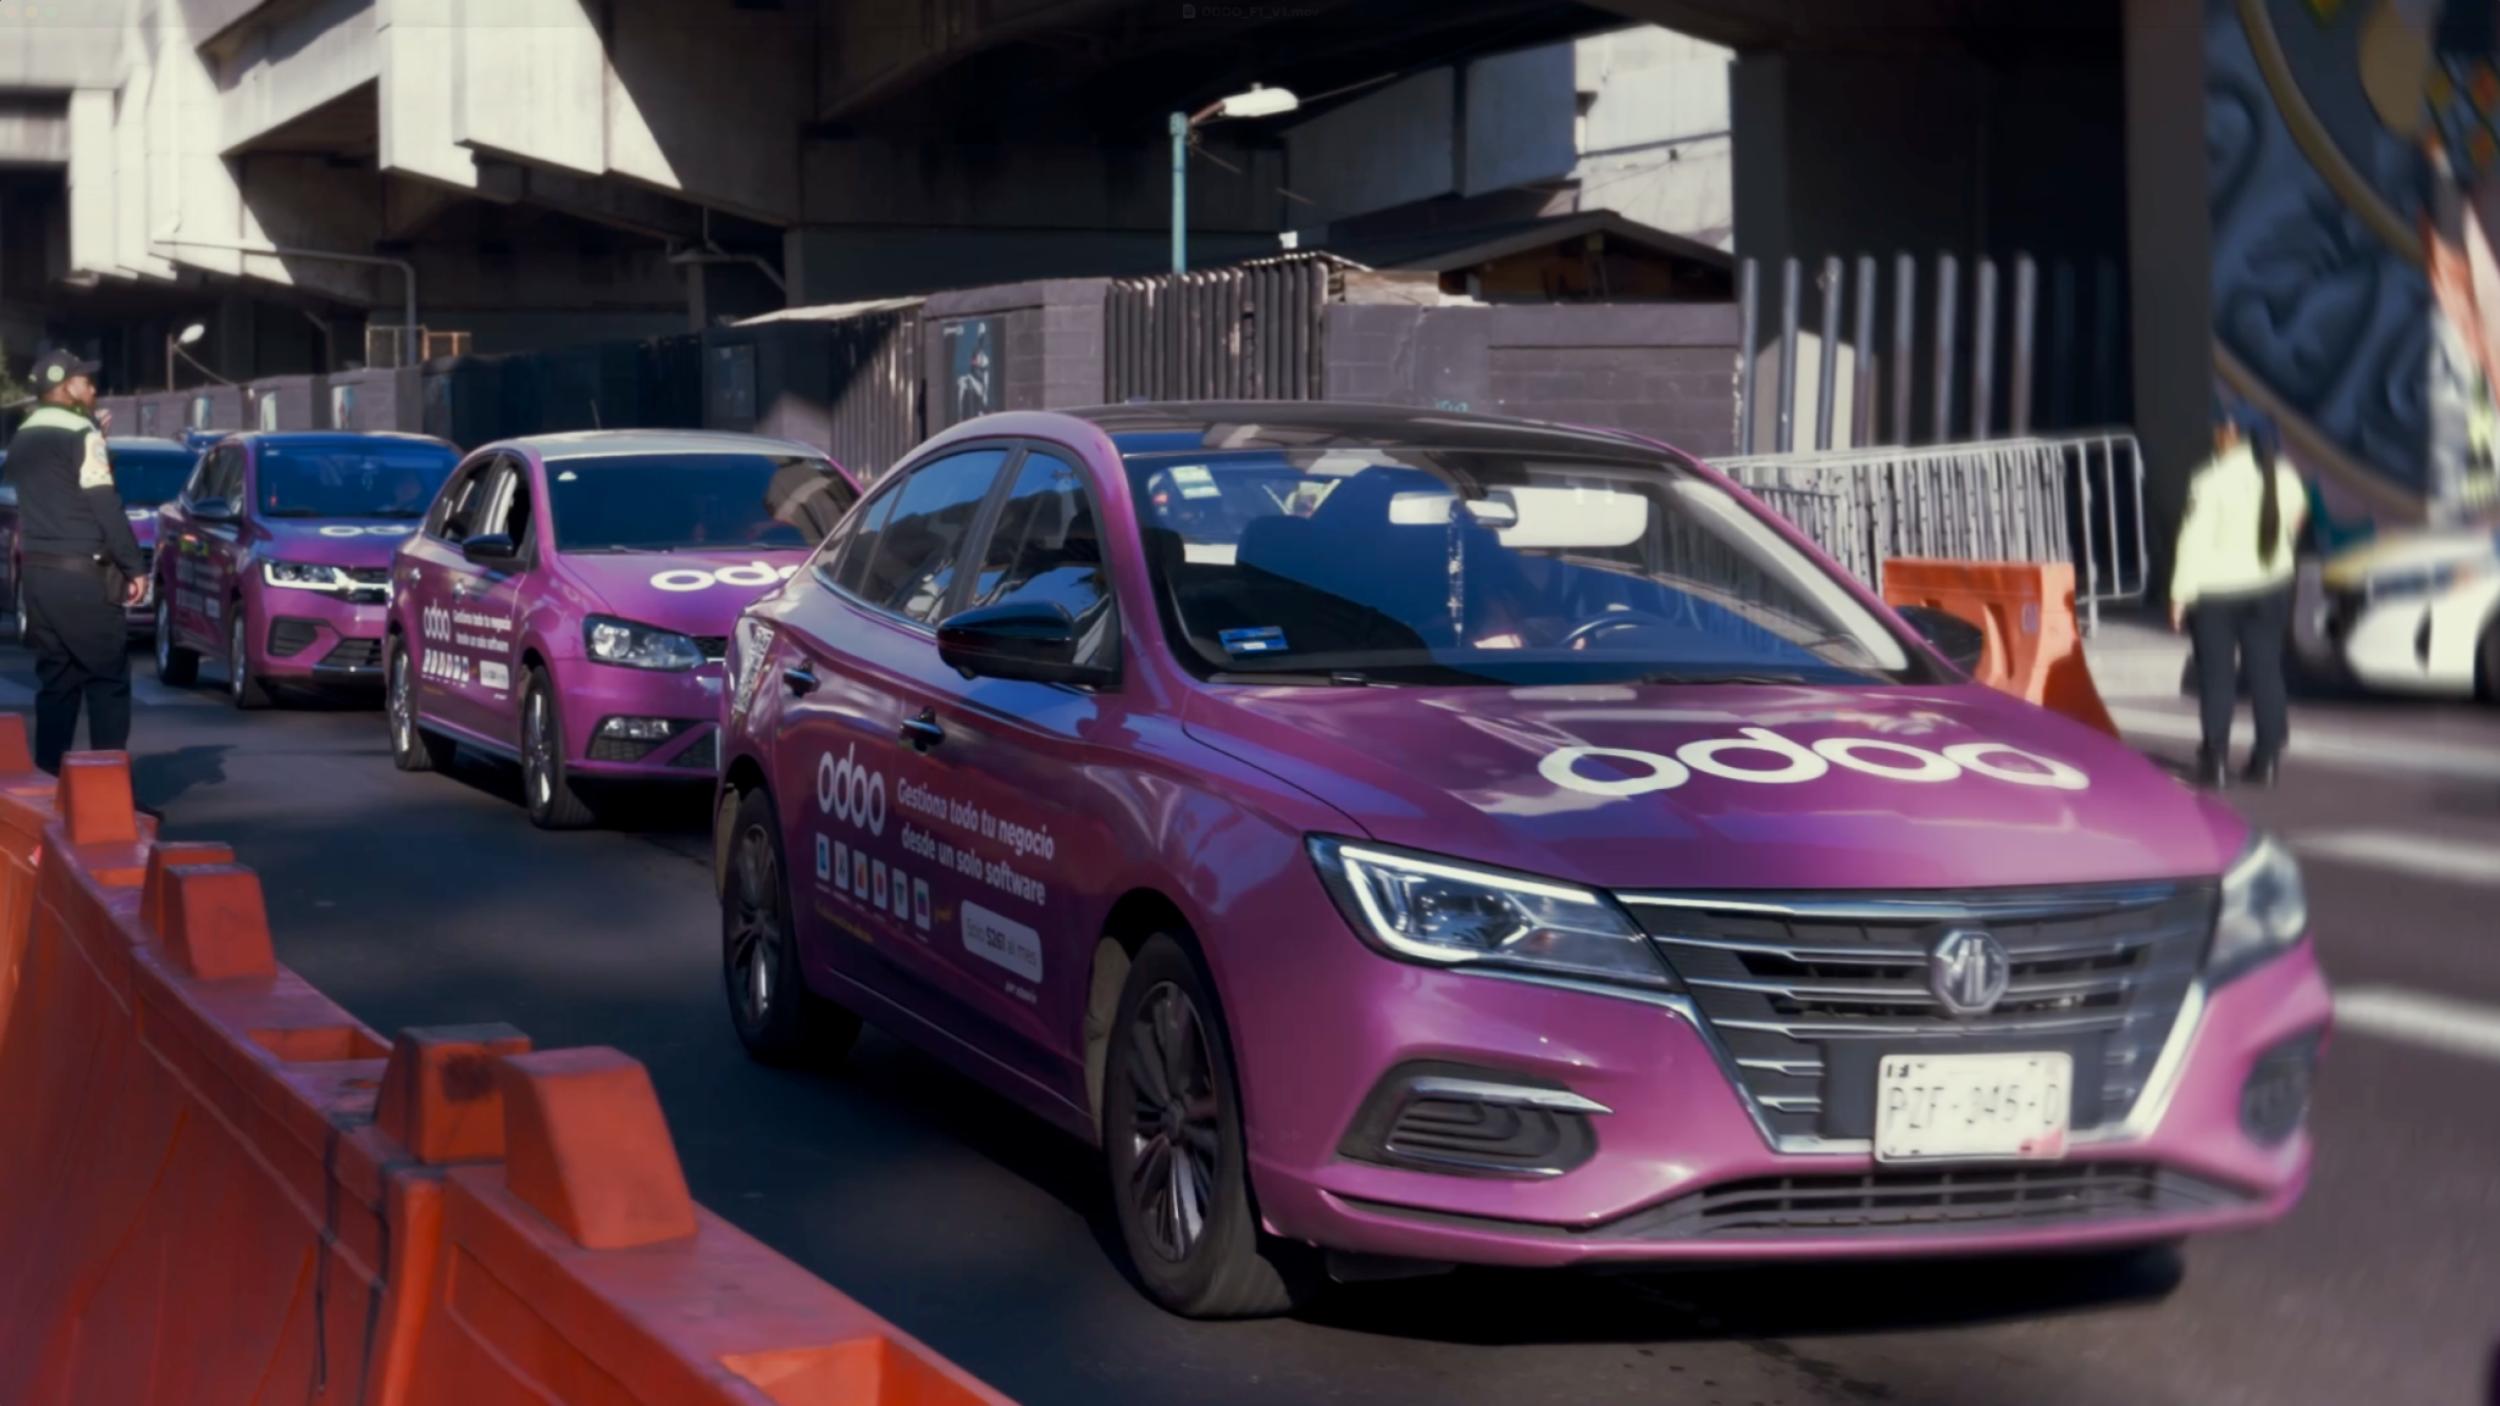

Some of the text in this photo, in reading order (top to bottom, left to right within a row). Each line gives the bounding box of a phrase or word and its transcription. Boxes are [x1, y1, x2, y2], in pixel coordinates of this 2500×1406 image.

[423, 599, 451, 642] odoo
[817, 742, 885, 837] odoo
[1538, 727, 2090, 796] odoo
[897, 777, 1055, 862] Gestiona todo tu negocio
[901, 822, 1046, 905] desde un solo software
